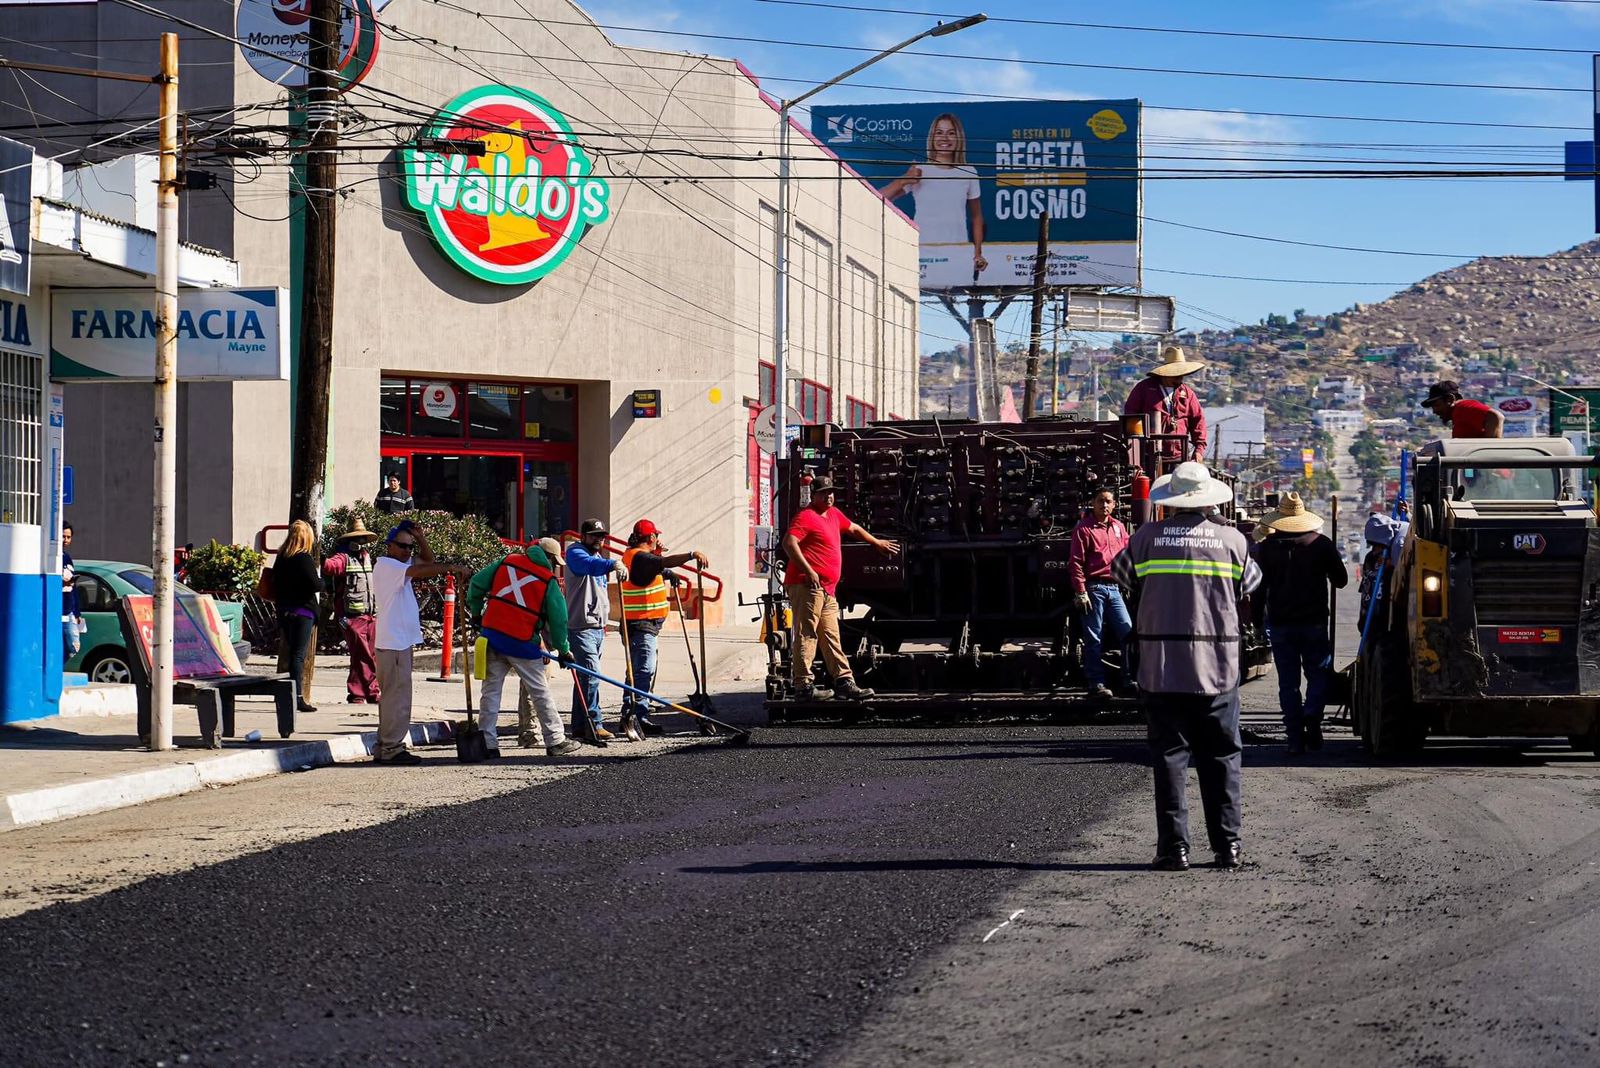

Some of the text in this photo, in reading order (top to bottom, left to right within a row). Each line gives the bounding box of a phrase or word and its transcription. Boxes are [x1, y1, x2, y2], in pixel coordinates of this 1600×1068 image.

[248, 31, 309, 49] MoneyG
[854, 116, 913, 132] Cosmo
[1012, 128, 1021, 139] SI
[1046, 128, 1057, 139] EN
[1060, 128, 1072, 139] TU
[996, 141, 1087, 170] RECETA
[412, 151, 605, 219] Waldo's
[995, 188, 1087, 220] COSMO
[228, 342, 266, 354] Mayne
[1205, 528, 1215, 537] DE
[1154, 537, 1224, 549] INFRAESTRUCTURA
[1513, 534, 1538, 549] CAT
